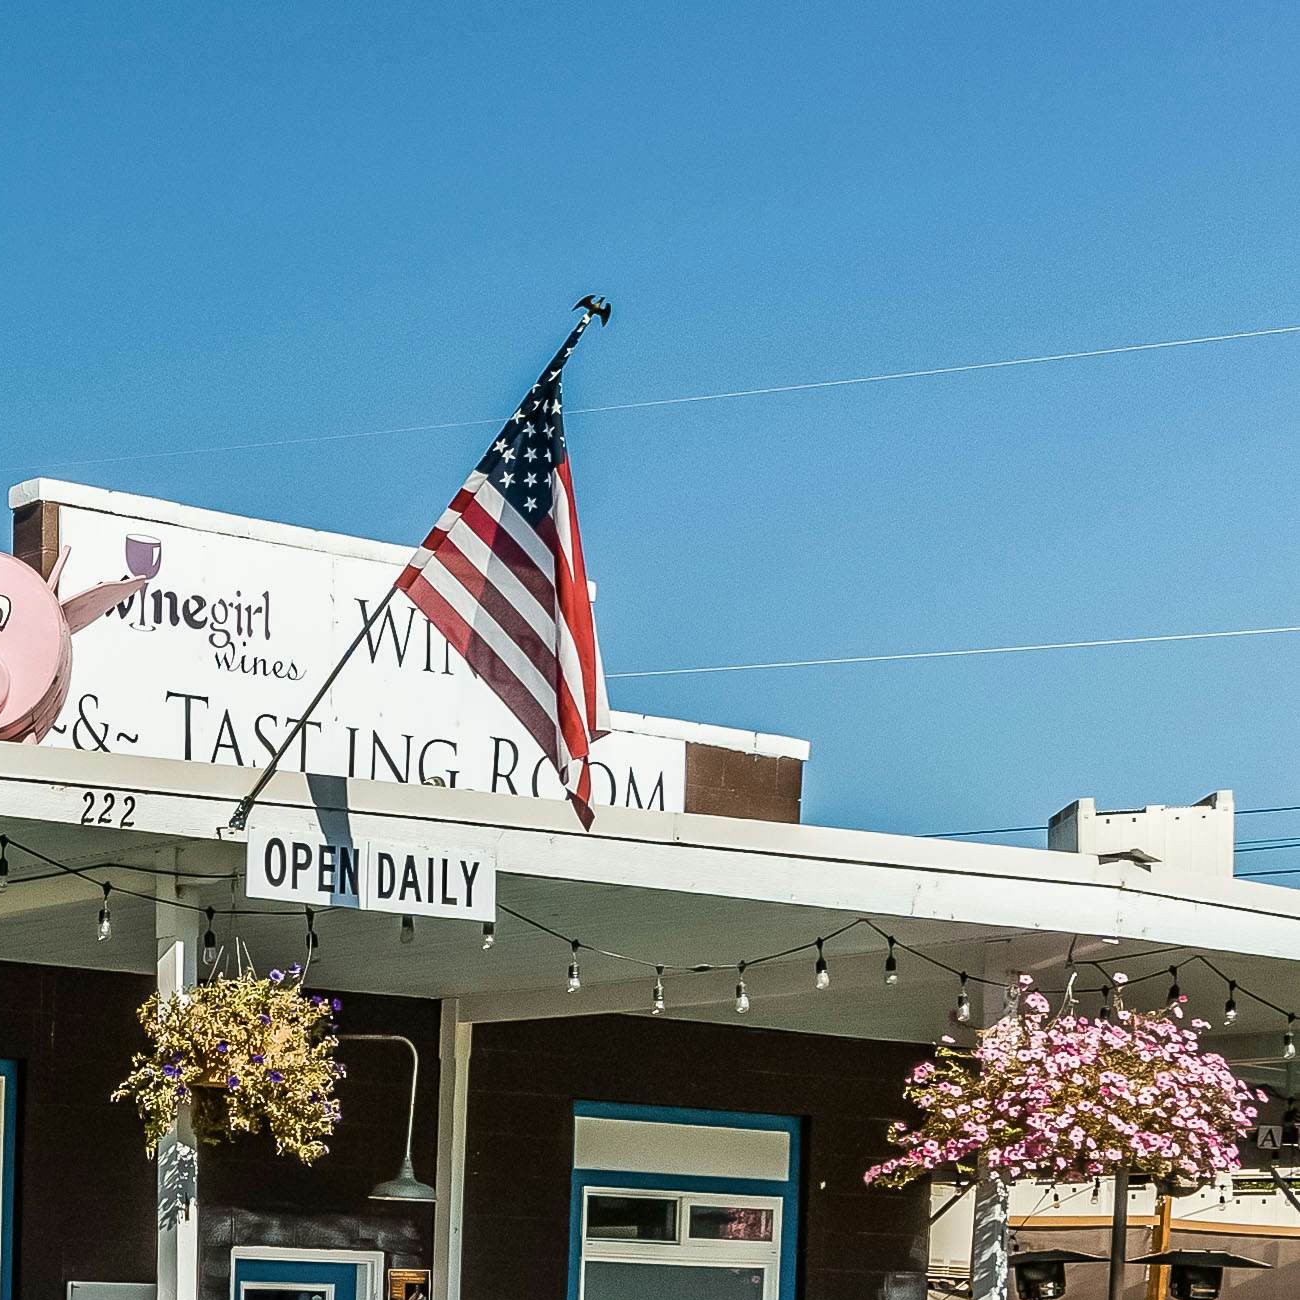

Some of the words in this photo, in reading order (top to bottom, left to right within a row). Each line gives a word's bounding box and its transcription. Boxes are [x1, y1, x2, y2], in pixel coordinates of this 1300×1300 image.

[165, 690, 460, 790] TASTING
[81, 791, 137, 828] 222
[264, 837, 359, 896] OPEN
[377, 852, 479, 907] DAILY
